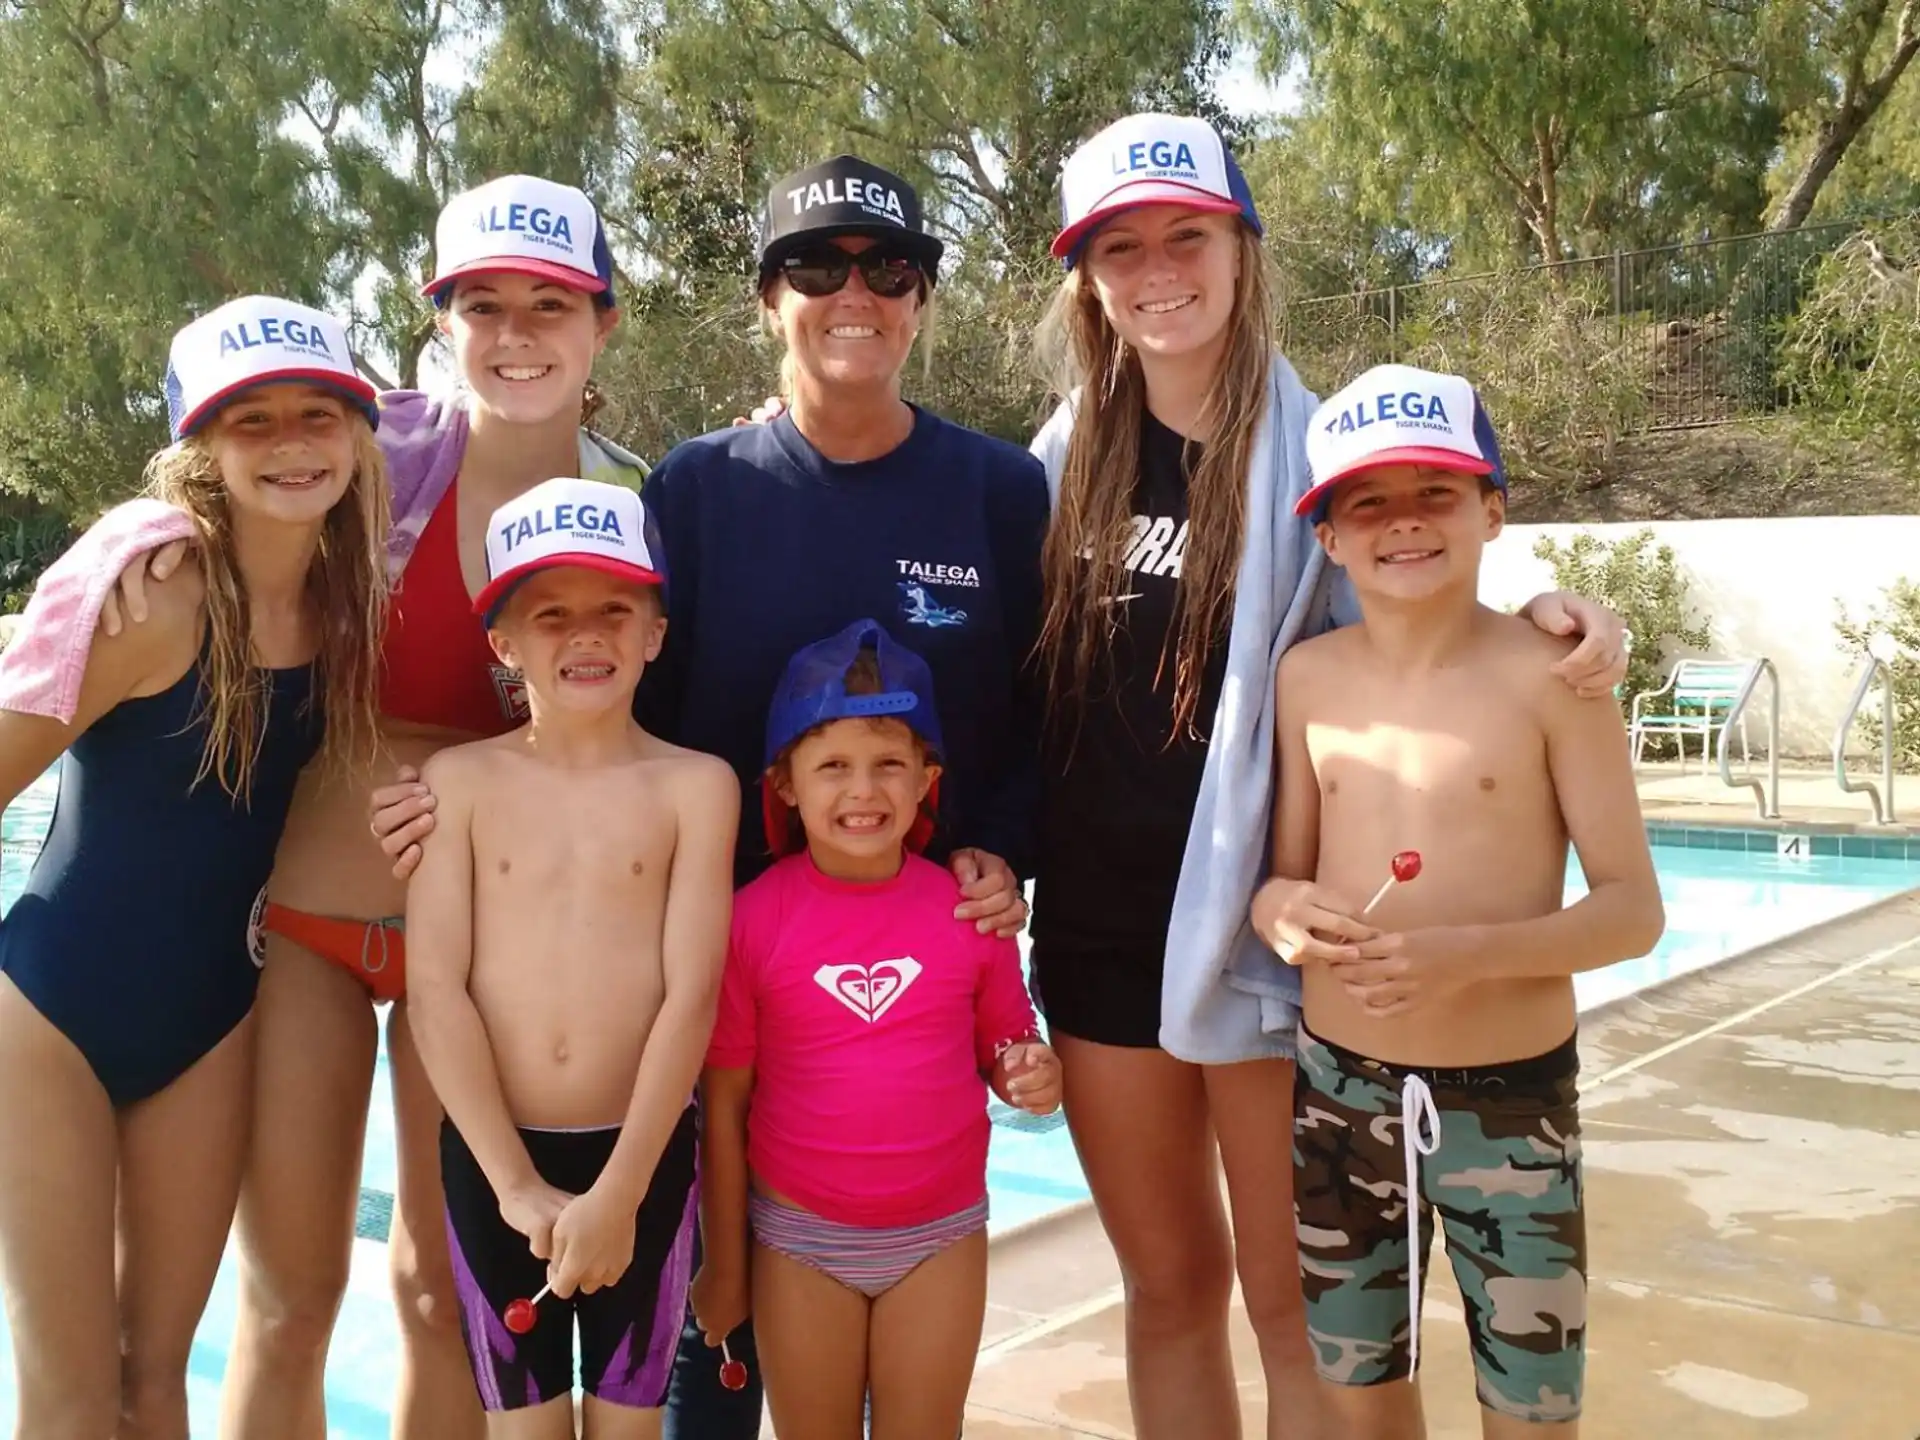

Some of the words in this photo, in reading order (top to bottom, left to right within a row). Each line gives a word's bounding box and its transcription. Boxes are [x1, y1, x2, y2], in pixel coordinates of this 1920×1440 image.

[1169, 170, 1199, 179] SHARKS
[787, 177, 905, 218] TALEGA
[861, 204, 881, 216] TIGER
[522, 233, 545, 244] TIGER
[546, 238, 574, 254] SHARKS
[1395, 420, 1421, 429] TIGER
[1422, 421, 1453, 435] SHARKS
[501, 504, 623, 552] TALEGA
[571, 531, 595, 540] TIGER
[596, 533, 625, 547] SHARKS
[896, 559, 980, 581] TALEGA
[918, 575, 943, 585] TIGER
[944, 578, 980, 588] SHARKS
